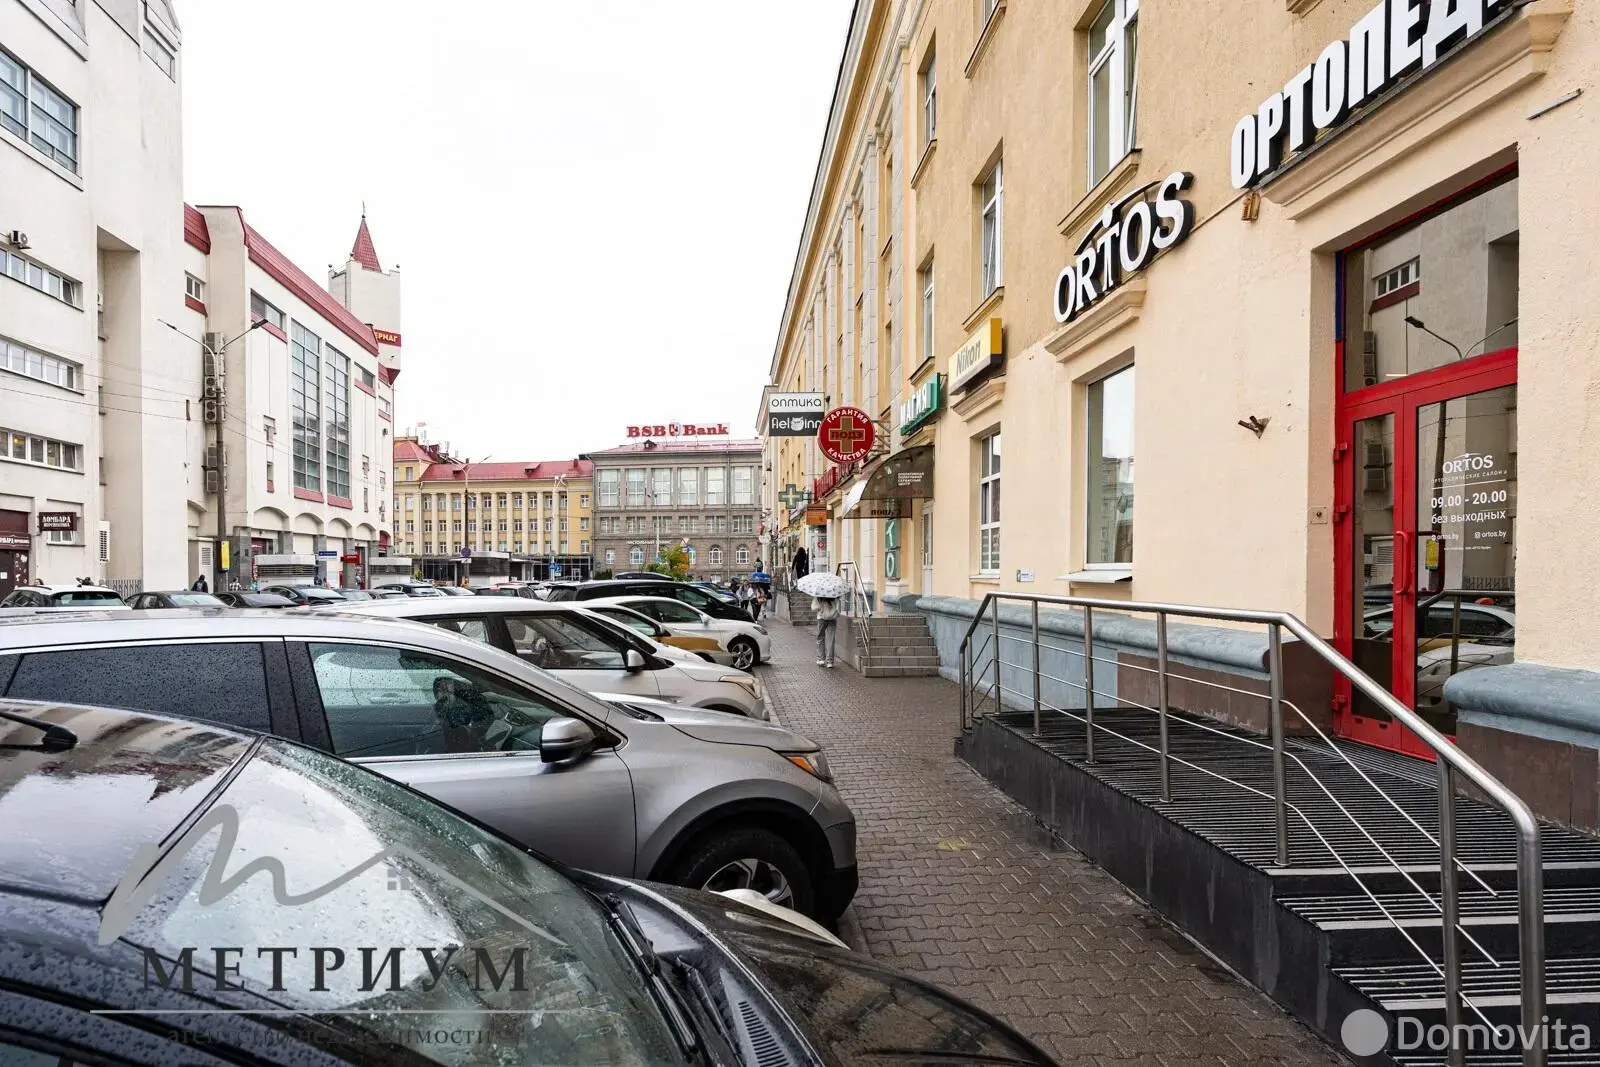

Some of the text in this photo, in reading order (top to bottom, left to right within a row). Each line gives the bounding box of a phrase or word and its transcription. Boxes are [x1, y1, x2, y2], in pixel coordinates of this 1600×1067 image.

[1231, 0, 1499, 189] ОРТОПЕД
[1053, 171, 1186, 323] ORTOS
[956, 340, 981, 377] Nikon
[826, 409, 868, 424] ГАРАНТИЯ
[627, 423, 729, 437] BSB Bank
[827, 447, 867, 461] КАЧЕСТВА
[1442, 454, 1493, 473] ORTOS
[1431, 495, 1461, 508] 09.00
[1472, 490, 1507, 505] 20.00
[1431, 510, 1506, 524] без выходных
[1482, 530, 1506, 539] ortos.by
